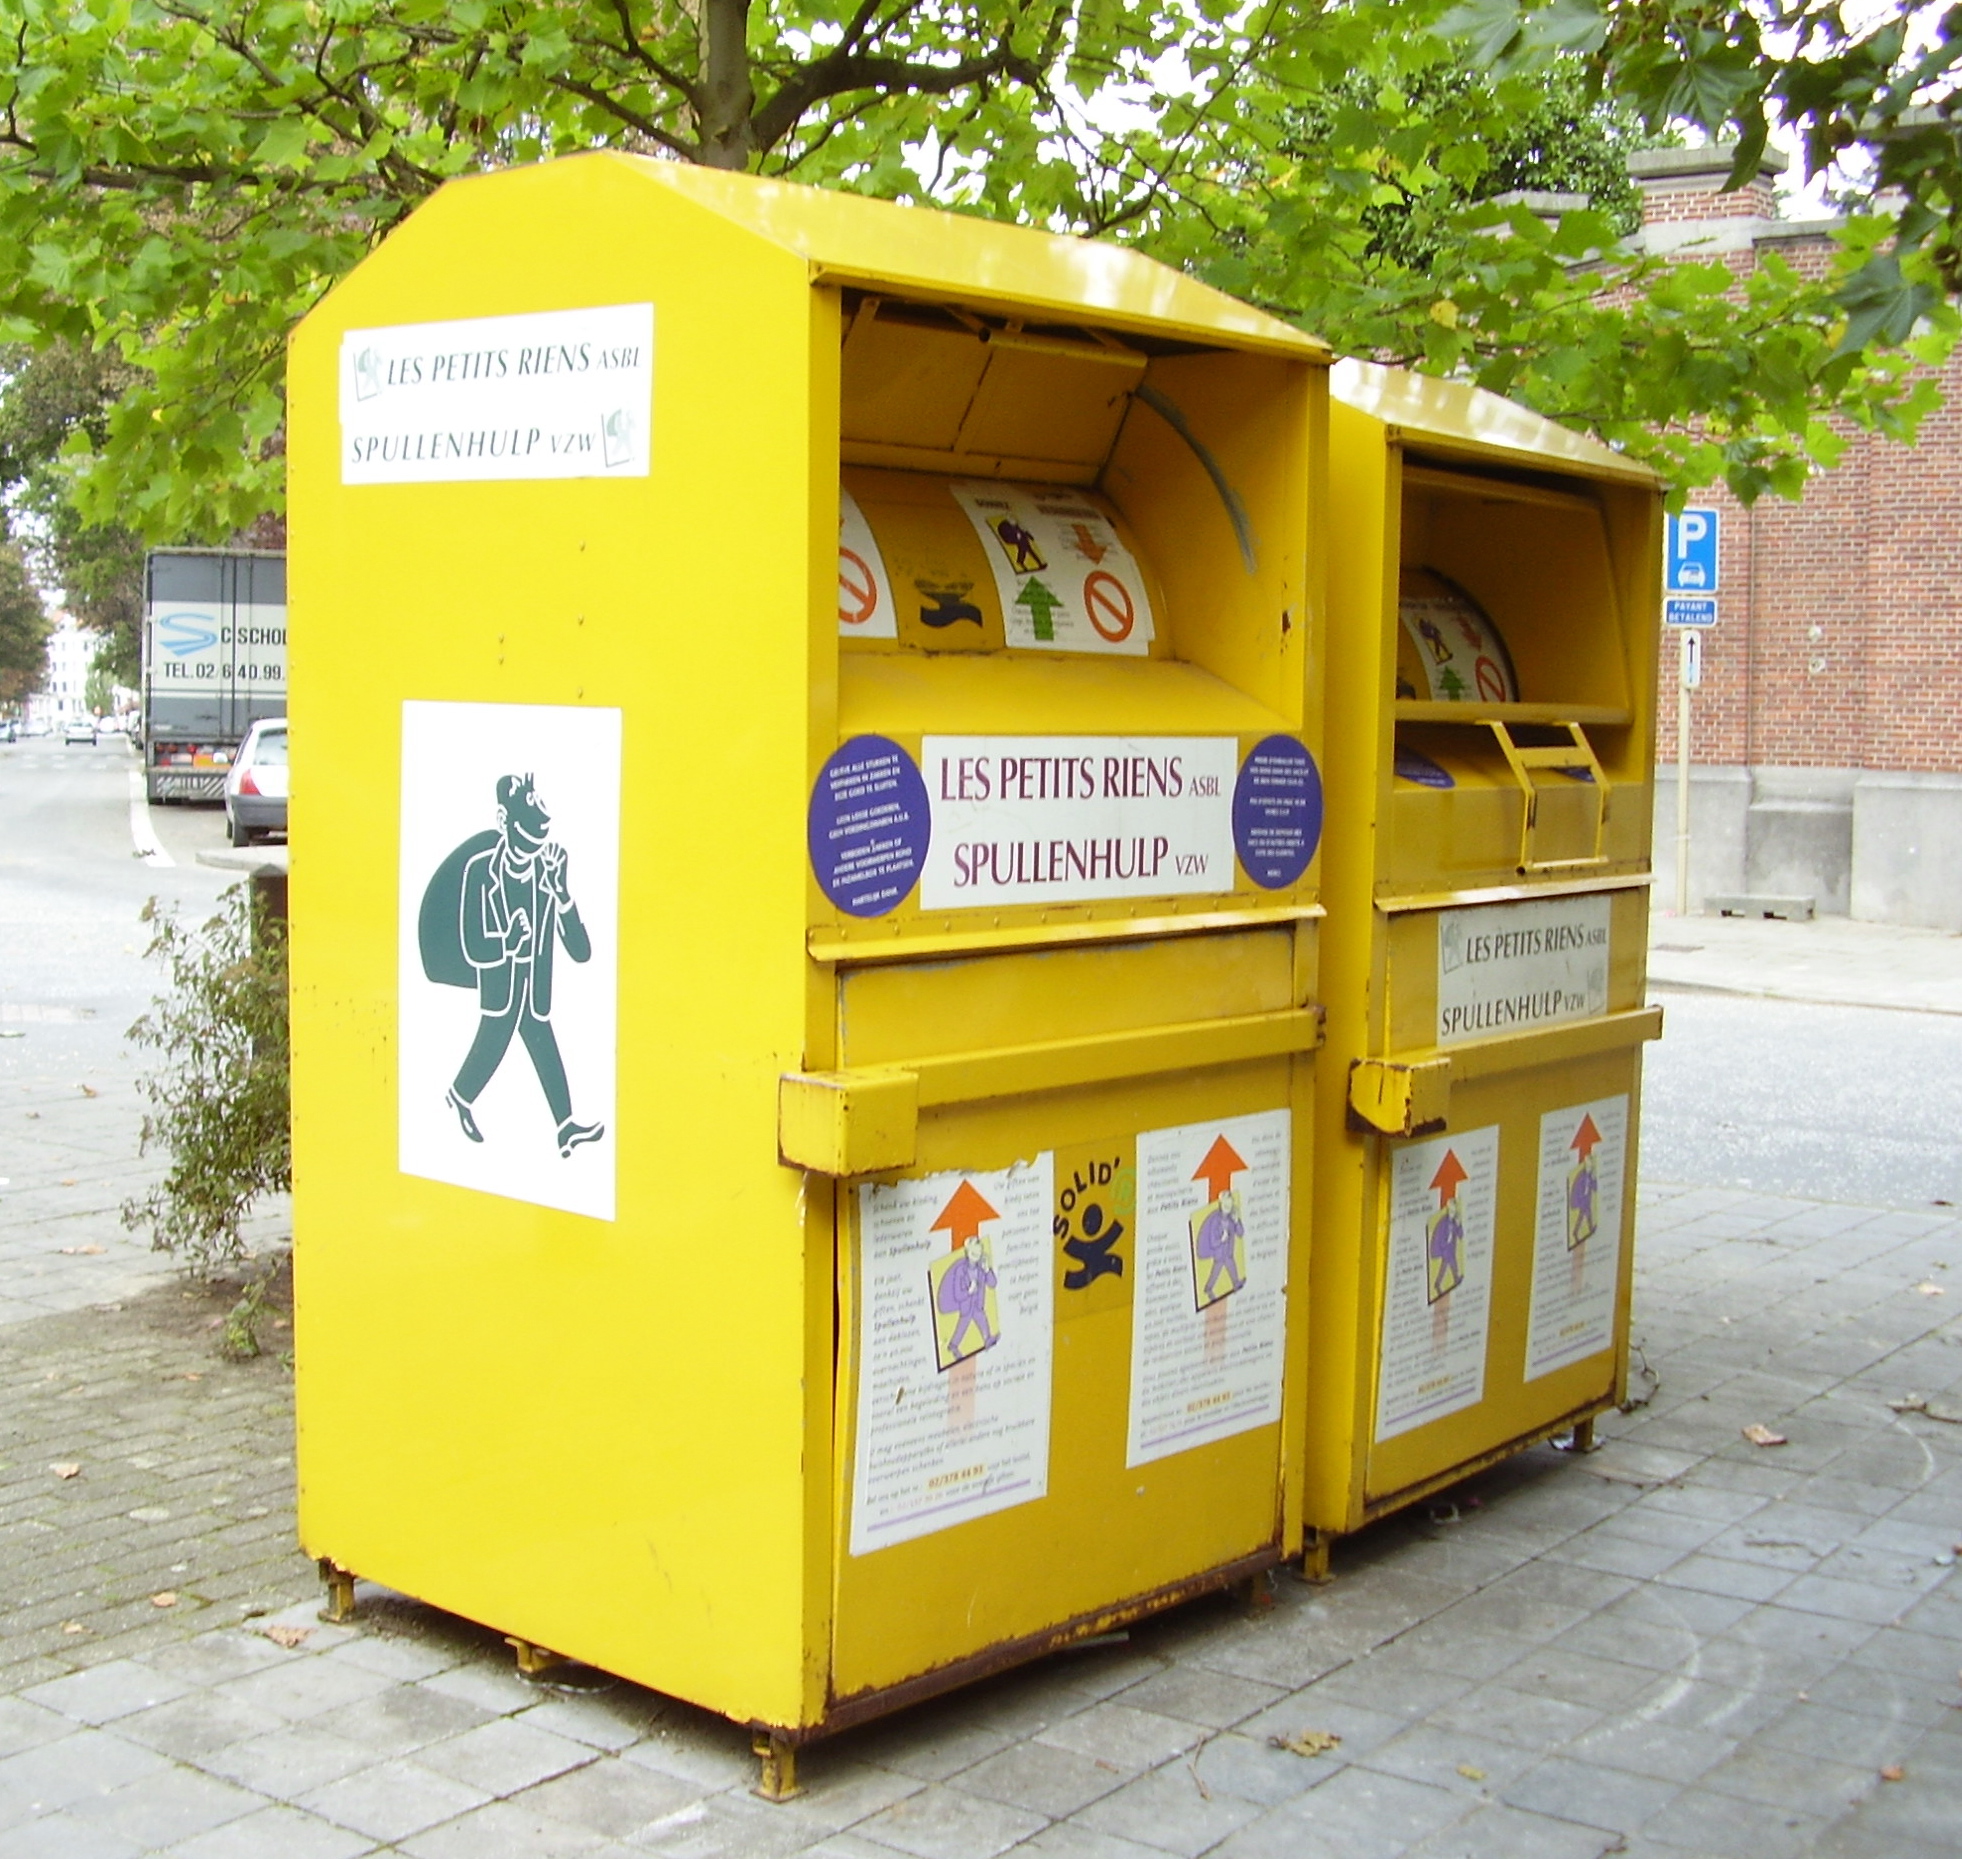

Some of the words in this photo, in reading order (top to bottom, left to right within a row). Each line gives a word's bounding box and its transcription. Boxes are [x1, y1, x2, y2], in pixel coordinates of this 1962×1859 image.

[388, 356, 422, 386] LES
[432, 349, 508, 382] PETITS
[518, 342, 591, 377] RIENS
[597, 346, 641, 370] ASBL
[352, 427, 540, 463] SPULLENHULP
[550, 432, 595, 454] VZW
[1678, 513, 1707, 559] P
[941, 756, 991, 802] LES
[1000, 756, 1095, 800] PETITS
[1103, 756, 1183, 798] RIENS
[1189, 775, 1221, 797] ASBL
[954, 836, 1169, 887] SPULLENHULP
[1175, 854, 1208, 876] VZW
[1466, 935, 1490, 964] LES
[1494, 929, 1541, 960] PETITS
[1544, 922, 1585, 952] RIENS
[1585, 927, 1607, 947] ASBL
[1442, 989, 1562, 1036] SPULLENHULP
[1563, 993, 1585, 1012] VZW
